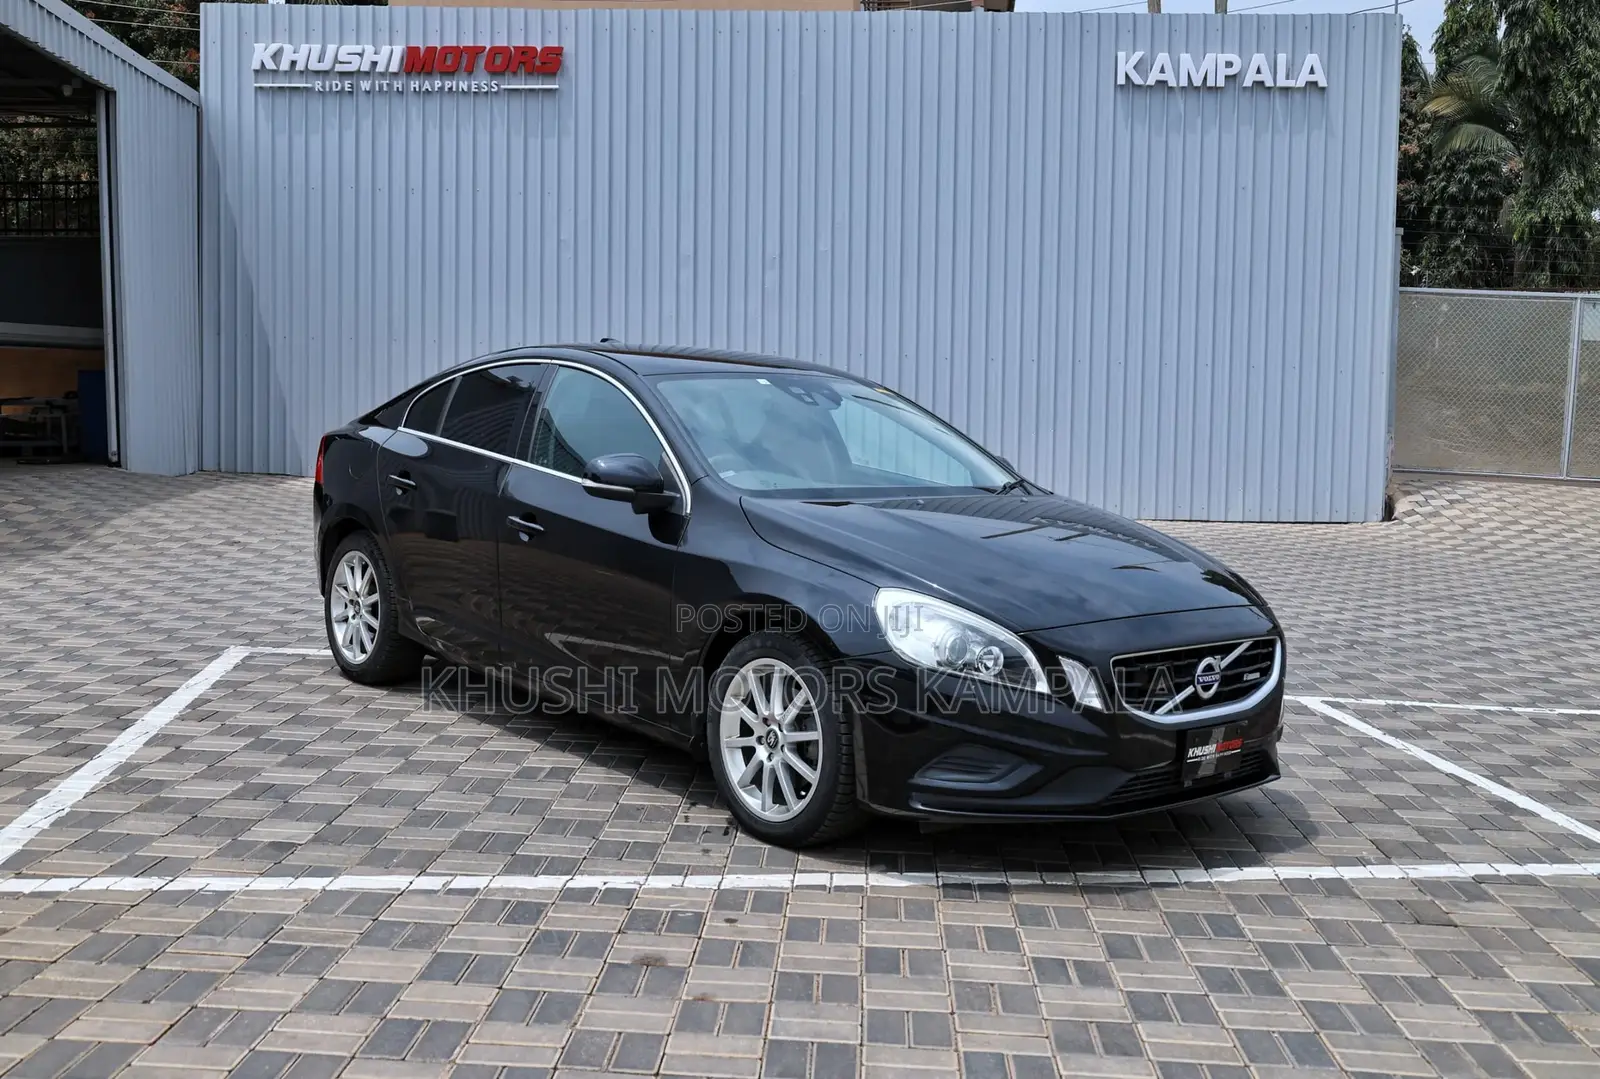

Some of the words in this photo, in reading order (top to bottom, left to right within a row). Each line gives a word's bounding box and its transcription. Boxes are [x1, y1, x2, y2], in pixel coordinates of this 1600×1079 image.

[1117, 51, 1328, 88] KAMPALA
[314, 80, 353, 92] RIDE
[360, 80, 402, 92] WITH
[410, 80, 499, 93] HAPPINESS
[1197, 674, 1220, 682] VOLVO
